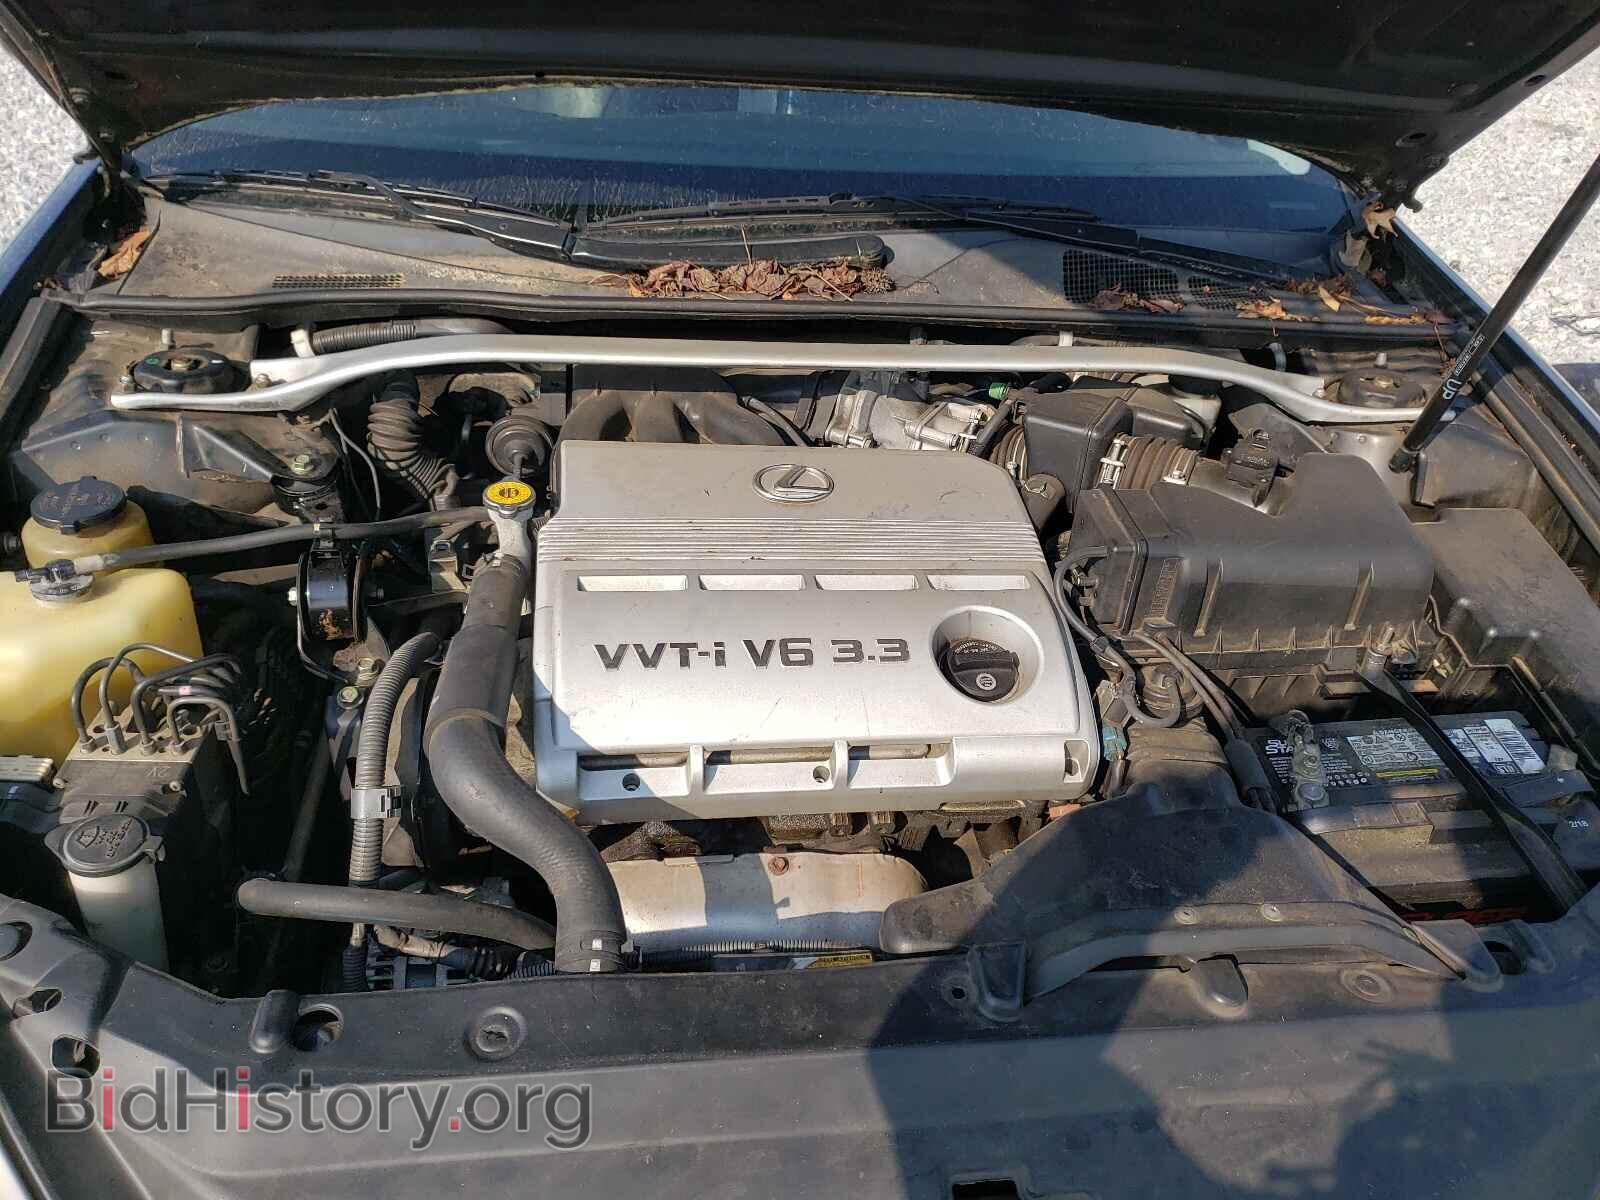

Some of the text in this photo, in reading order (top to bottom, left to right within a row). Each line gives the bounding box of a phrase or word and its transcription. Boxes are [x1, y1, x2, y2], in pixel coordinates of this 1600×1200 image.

[1442, 378, 1463, 400] UP
[594, 636, 912, 671] VVT-i V6 3.3
